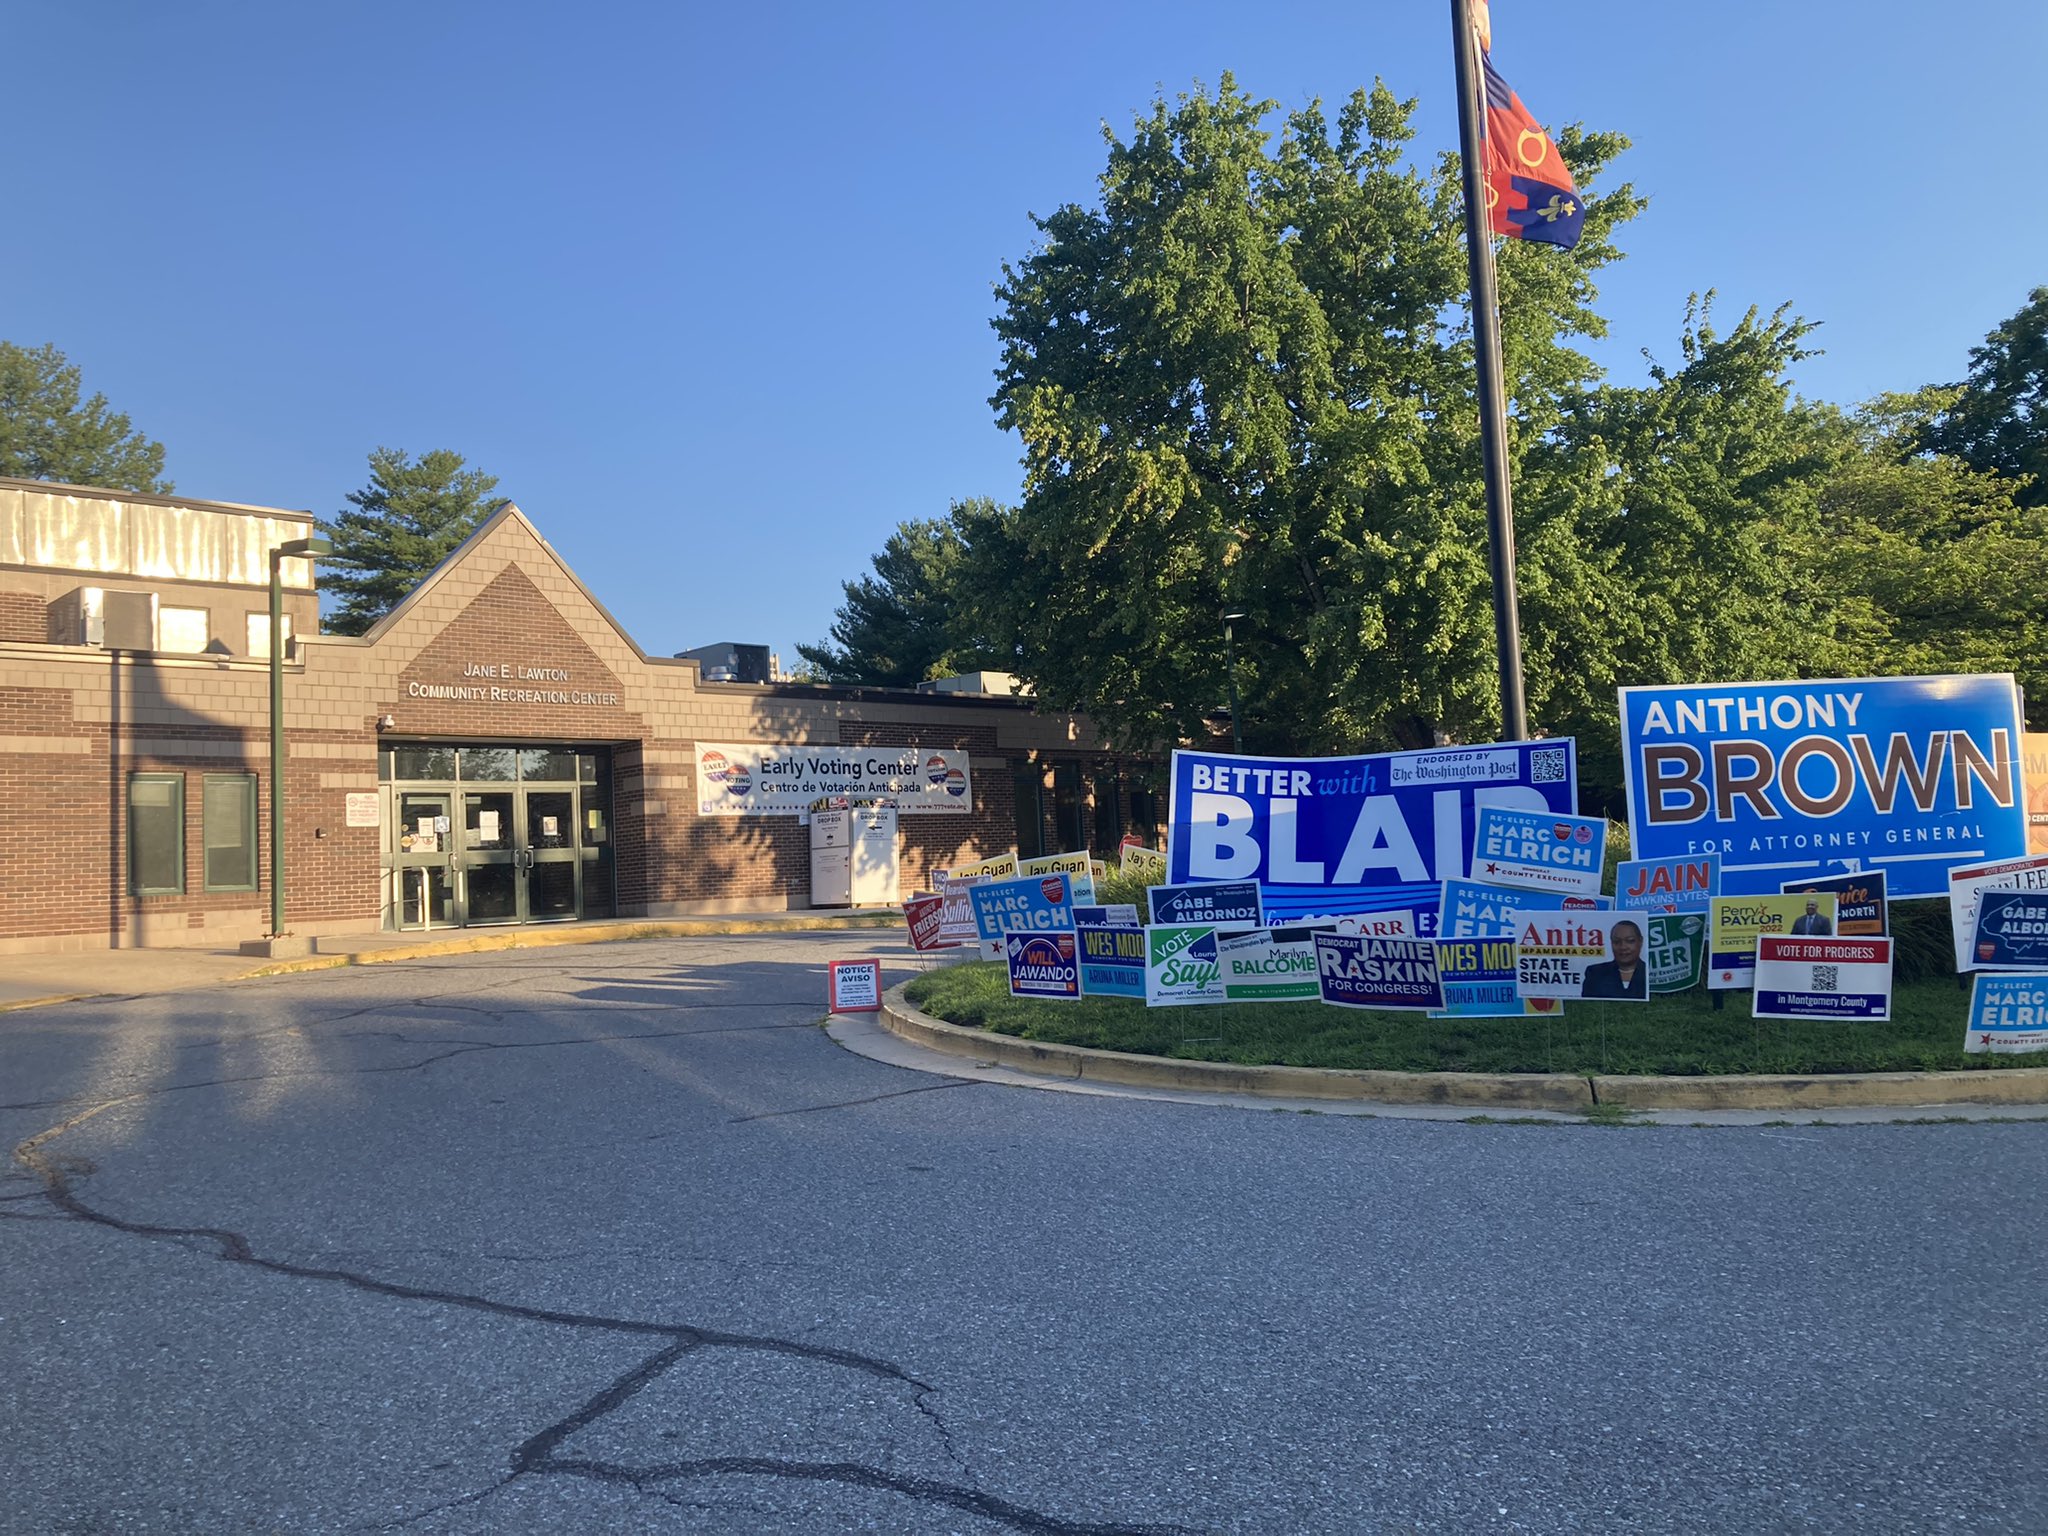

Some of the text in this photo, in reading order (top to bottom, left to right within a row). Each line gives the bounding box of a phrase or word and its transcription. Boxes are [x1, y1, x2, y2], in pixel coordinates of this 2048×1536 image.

[464, 662, 568, 681] JANE E. LAWTON
[408, 681, 618, 706] COMMUNITY RECREATION CENTER
[1641, 692, 1864, 736] ANTHONY
[1416, 752, 1490, 765] ENDORSED BY
[760, 757, 919, 780] Early Voting Center
[1392, 761, 1517, 782] The Washington Post
[1191, 763, 1377, 796] BETTER with
[1640, 727, 2016, 827] BROWN
[760, 781, 921, 795] Centro de Votación Anticipada
[1489, 814, 1538, 825] RE-ELECT
[1188, 785, 1551, 884] BLAI
[1488, 823, 1550, 842] MARC
[1687, 824, 1986, 855] FOR ATTORNEY GENERAL
[1128, 852, 1145, 868] Jay
[1486, 837, 1592, 867] ELRICH
[981, 862, 1013, 877] Guan
[1051, 860, 1085, 873] Guan
[1501, 869, 1582, 884] COUNTY EXECUTIVE
[1626, 862, 1710, 897] JAIN
[978, 888, 1016, 898] RE-ELECT
[1458, 889, 1521, 905] RE-ELECT
[1625, 891, 1710, 908] HAWKINS LYTES
[980, 895, 1030, 914] MARC
[1172, 897, 1214, 910] GABE
[1721, 905, 1759, 917] Perry
[983, 906, 1069, 934] ELRICH
[1175, 907, 1257, 922] ALBORNOZ
[1456, 900, 1516, 924] MAR
[1838, 906, 1876, 918] -NORTH
[2001, 906, 2047, 919] GABE
[1339, 918, 1406, 936] ARR
[1721, 914, 1783, 927] PAYLOR
[1519, 919, 1605, 946] Anita
[1759, 925, 1783, 933] 2022
[1084, 932, 1145, 958] WES MOO
[1155, 929, 1193, 958] VOTE
[1317, 937, 1433, 962] DEMOCRAT JAMIE
[1027, 950, 1056, 966] WILL
[1269, 948, 1308, 960] Marilyn
[1435, 942, 1516, 972] WES MO
[1581, 948, 1604, 956] COX
[1776, 945, 1875, 959] VOTE FOR PROGRESS
[837, 966, 873, 975] NOTICE
[1318, 946, 1437, 983] RASKIN
[1519, 958, 1569, 971] STATE
[841, 974, 870, 983] AVISO
[1013, 965, 1075, 981] JAWANDO
[1088, 970, 1140, 985] ARUNA MILLER
[1519, 972, 1581, 985] SENATE
[1328, 979, 1433, 995] FOR CONGRESS!
[1444, 986, 1473, 1004] RUNA
[1476, 986, 1514, 1004] MILLER
[1777, 994, 1868, 1008] in Montgomery County
[1983, 991, 2046, 1006] MARC
